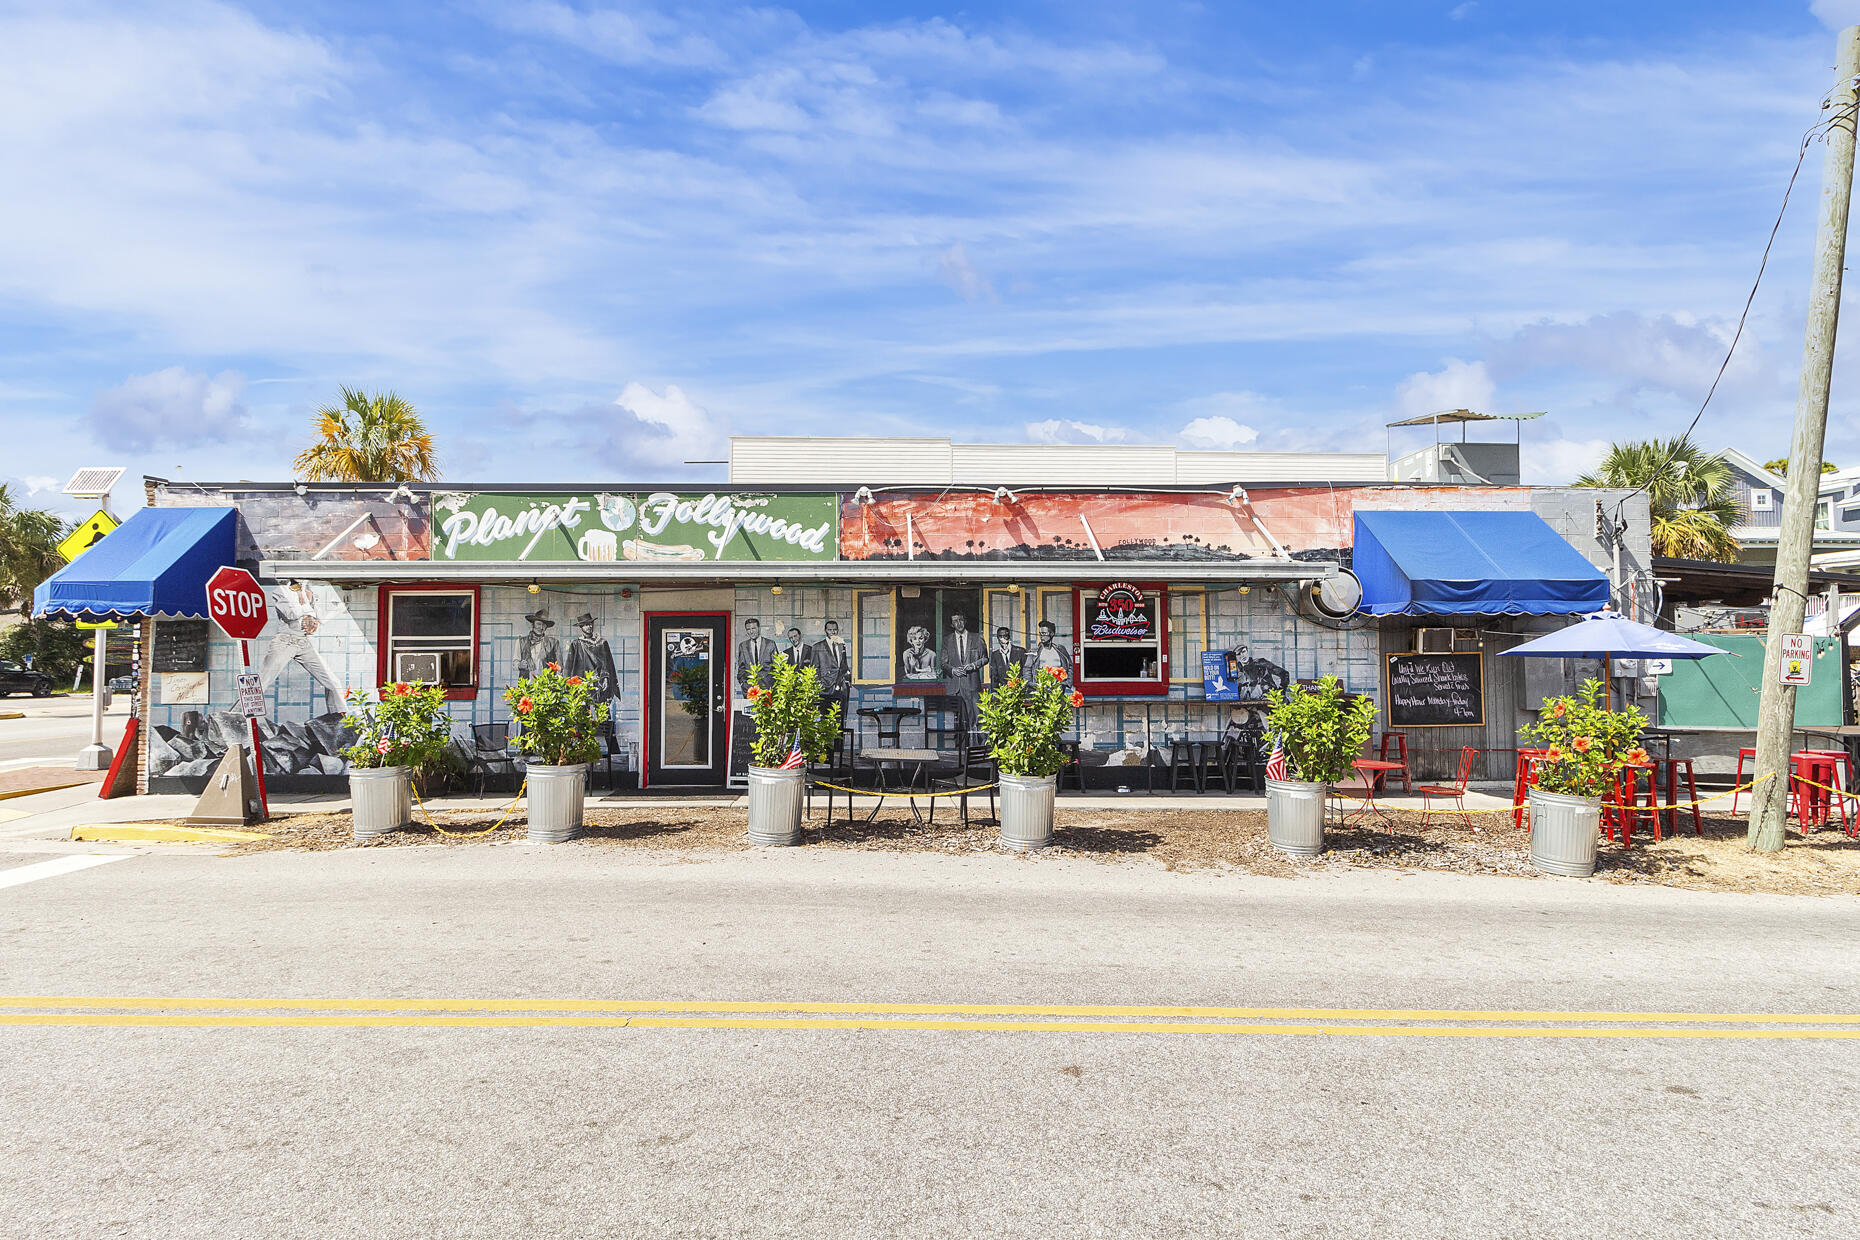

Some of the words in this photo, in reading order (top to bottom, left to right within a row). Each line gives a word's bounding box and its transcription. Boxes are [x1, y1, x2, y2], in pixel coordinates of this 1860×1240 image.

[442, 497, 590, 559] Planet
[640, 492, 830, 553] Follywood
[1118, 538, 1156, 546] FOLLYWOOD
[1100, 582, 1144, 601] CHARLESTON
[213, 588, 263, 618] STOP
[1109, 598, 1134, 612] 350
[1090, 624, 1148, 636] Budweiser
[1791, 638, 1803, 648] NO
[1782, 648, 1810, 660] PARKING
[1441, 661, 1455, 672] Out
[246, 678, 255, 686] NO
[241, 686, 261, 696] PARKING
[1394, 694, 1411, 707] Happy
